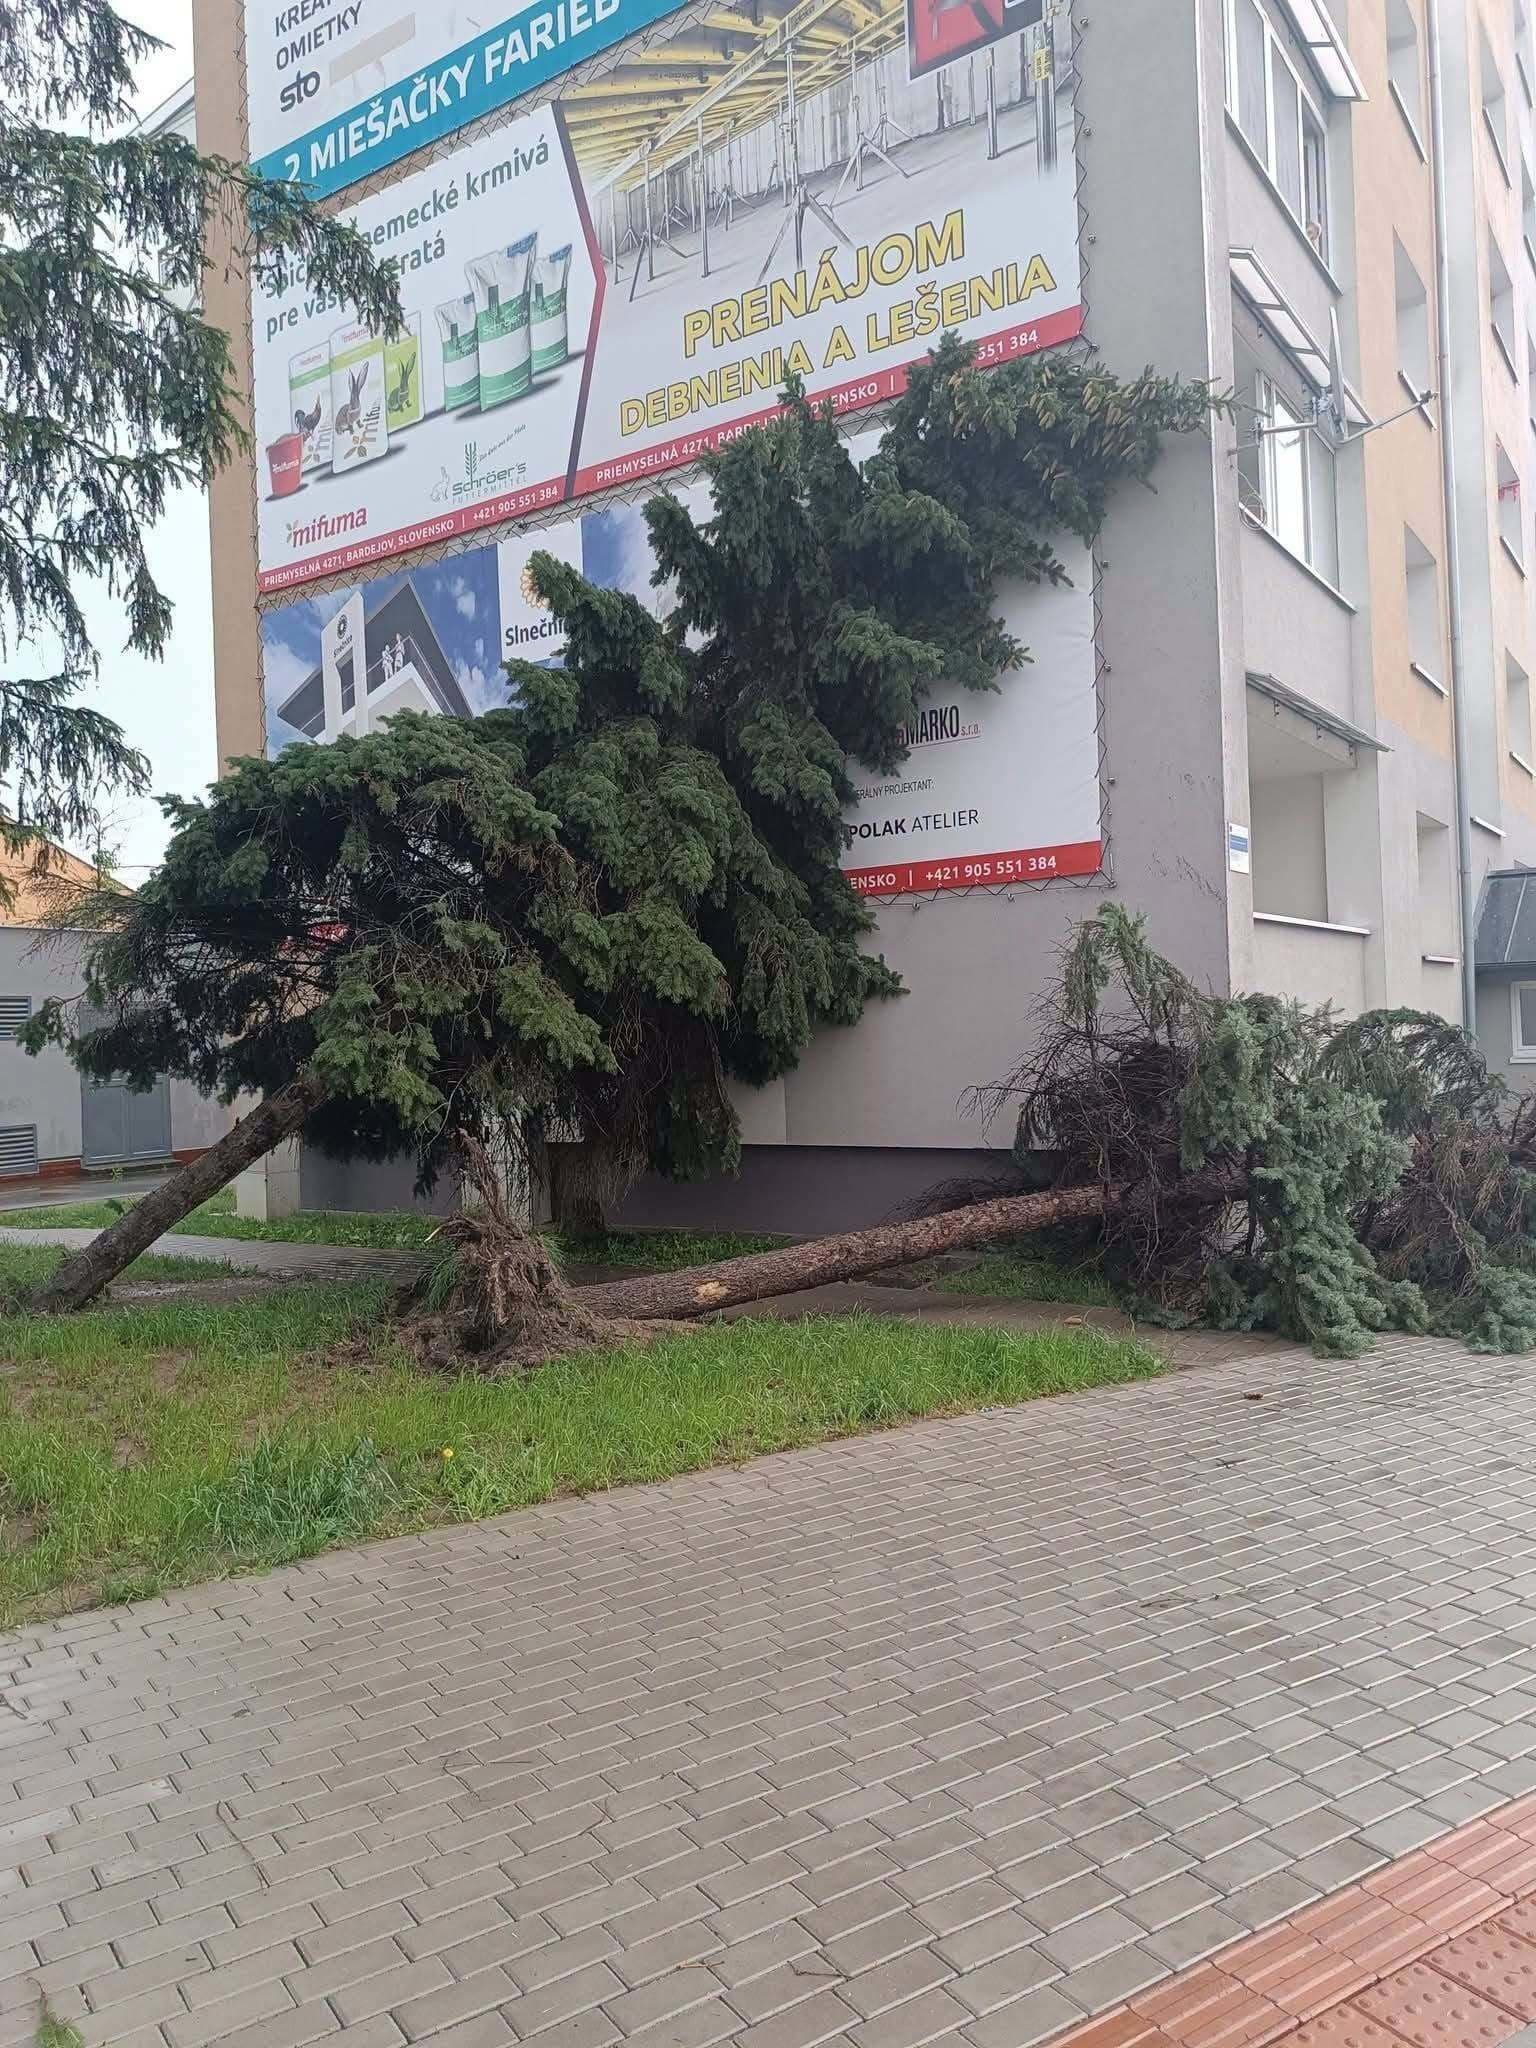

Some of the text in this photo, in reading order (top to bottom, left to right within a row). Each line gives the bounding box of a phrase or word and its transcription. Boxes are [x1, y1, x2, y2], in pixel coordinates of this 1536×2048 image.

[276, 1, 362, 70] OMIETKY
[280, 70, 321, 112] sto
[310, 54, 475, 178] MIEŠAČKY
[466, 133, 549, 200] krmivá
[683, 208, 964, 357] PRENÁJOM
[266, 307, 299, 342] pre
[620, 253, 1058, 436] DEBNENIA A LEŠENIA
[596, 447, 679, 482] PRIEMYSELNÁ
[1010, 329, 1038, 350] 384
[264, 485, 558, 587] PRIEMYSELNÁ 4271, BARDEJOV, SLOVENSKO +421 905 551 384
[292, 507, 368, 548] mifuma
[849, 809, 979, 839] POLAK ATELIER
[851, 855, 1057, 889] ENSKO +421 905 551 384
